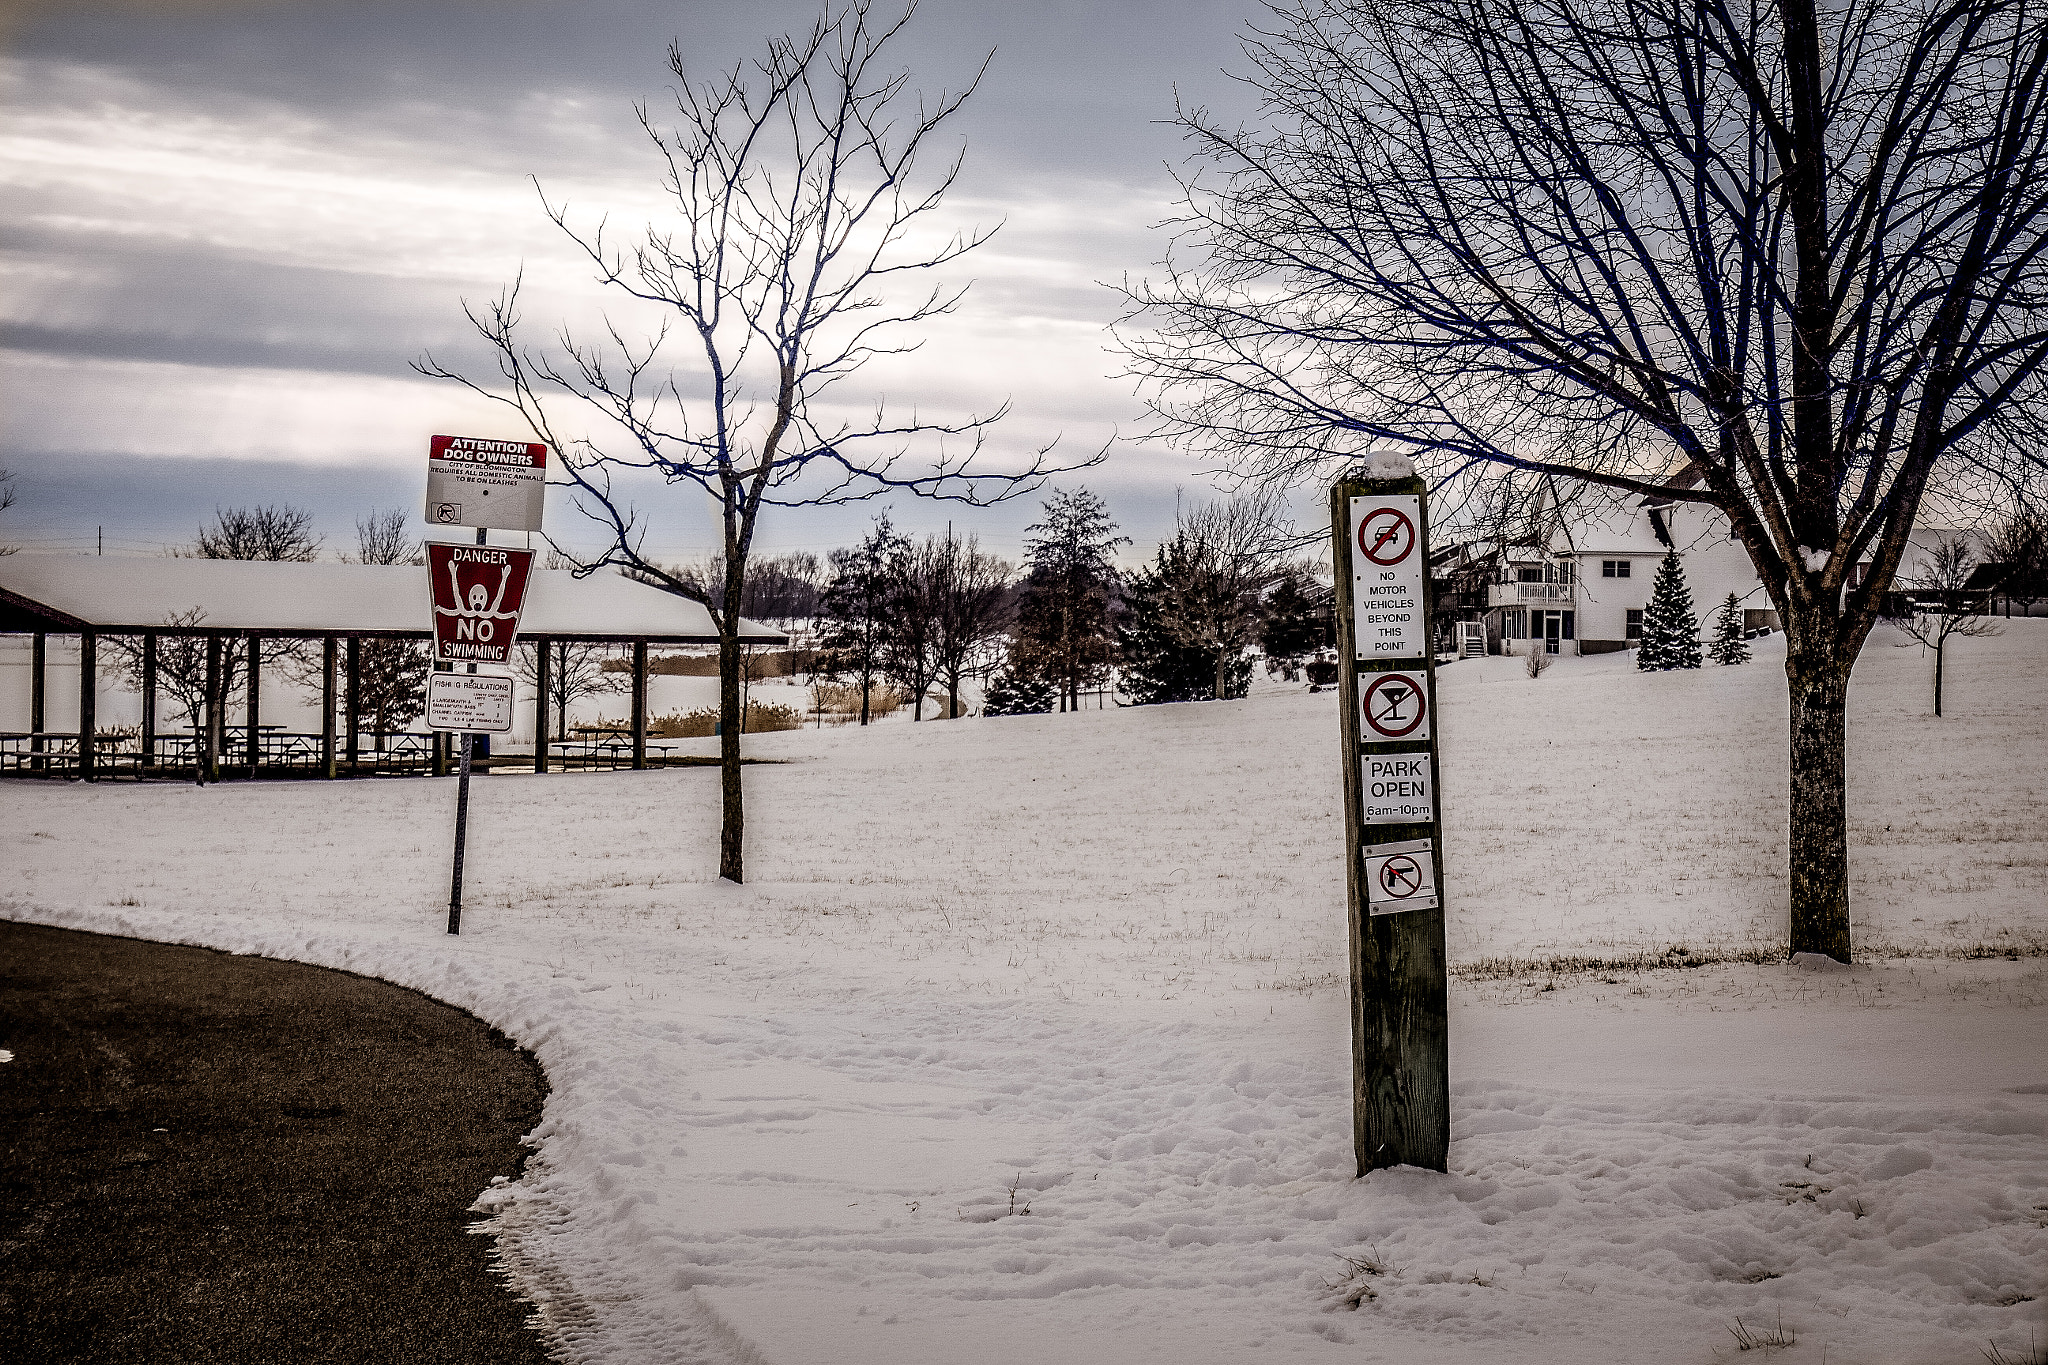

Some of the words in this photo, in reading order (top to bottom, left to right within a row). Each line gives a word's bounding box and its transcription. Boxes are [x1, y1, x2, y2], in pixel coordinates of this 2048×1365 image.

[451, 438, 528, 454] ATTENTION
[443, 448, 474, 461] DOG
[476, 452, 533, 466] OWNERS
[430, 467, 463, 475] REQUIRES
[478, 471, 512, 479] DOMESTIC
[513, 474, 544, 482] ANIMALS
[475, 464, 526, 474] BLOOMINGTON
[453, 548, 508, 564] DANGER
[1379, 571, 1395, 581] NO
[1369, 585, 1407, 595] MOTOR
[1363, 599, 1415, 609] VEHICLES
[1367, 613, 1411, 624] BEYOND
[456, 618, 494, 642] NO
[1378, 627, 1402, 637] THIS
[444, 642, 504, 660] SWIMMING
[1374, 641, 1406, 651] POINT
[463, 681, 509, 691] REGULATIONS
[1371, 760, 1423, 778] PARK
[1370, 781, 1425, 798] OPEN
[1367, 804, 1430, 817] 6am-10pm
